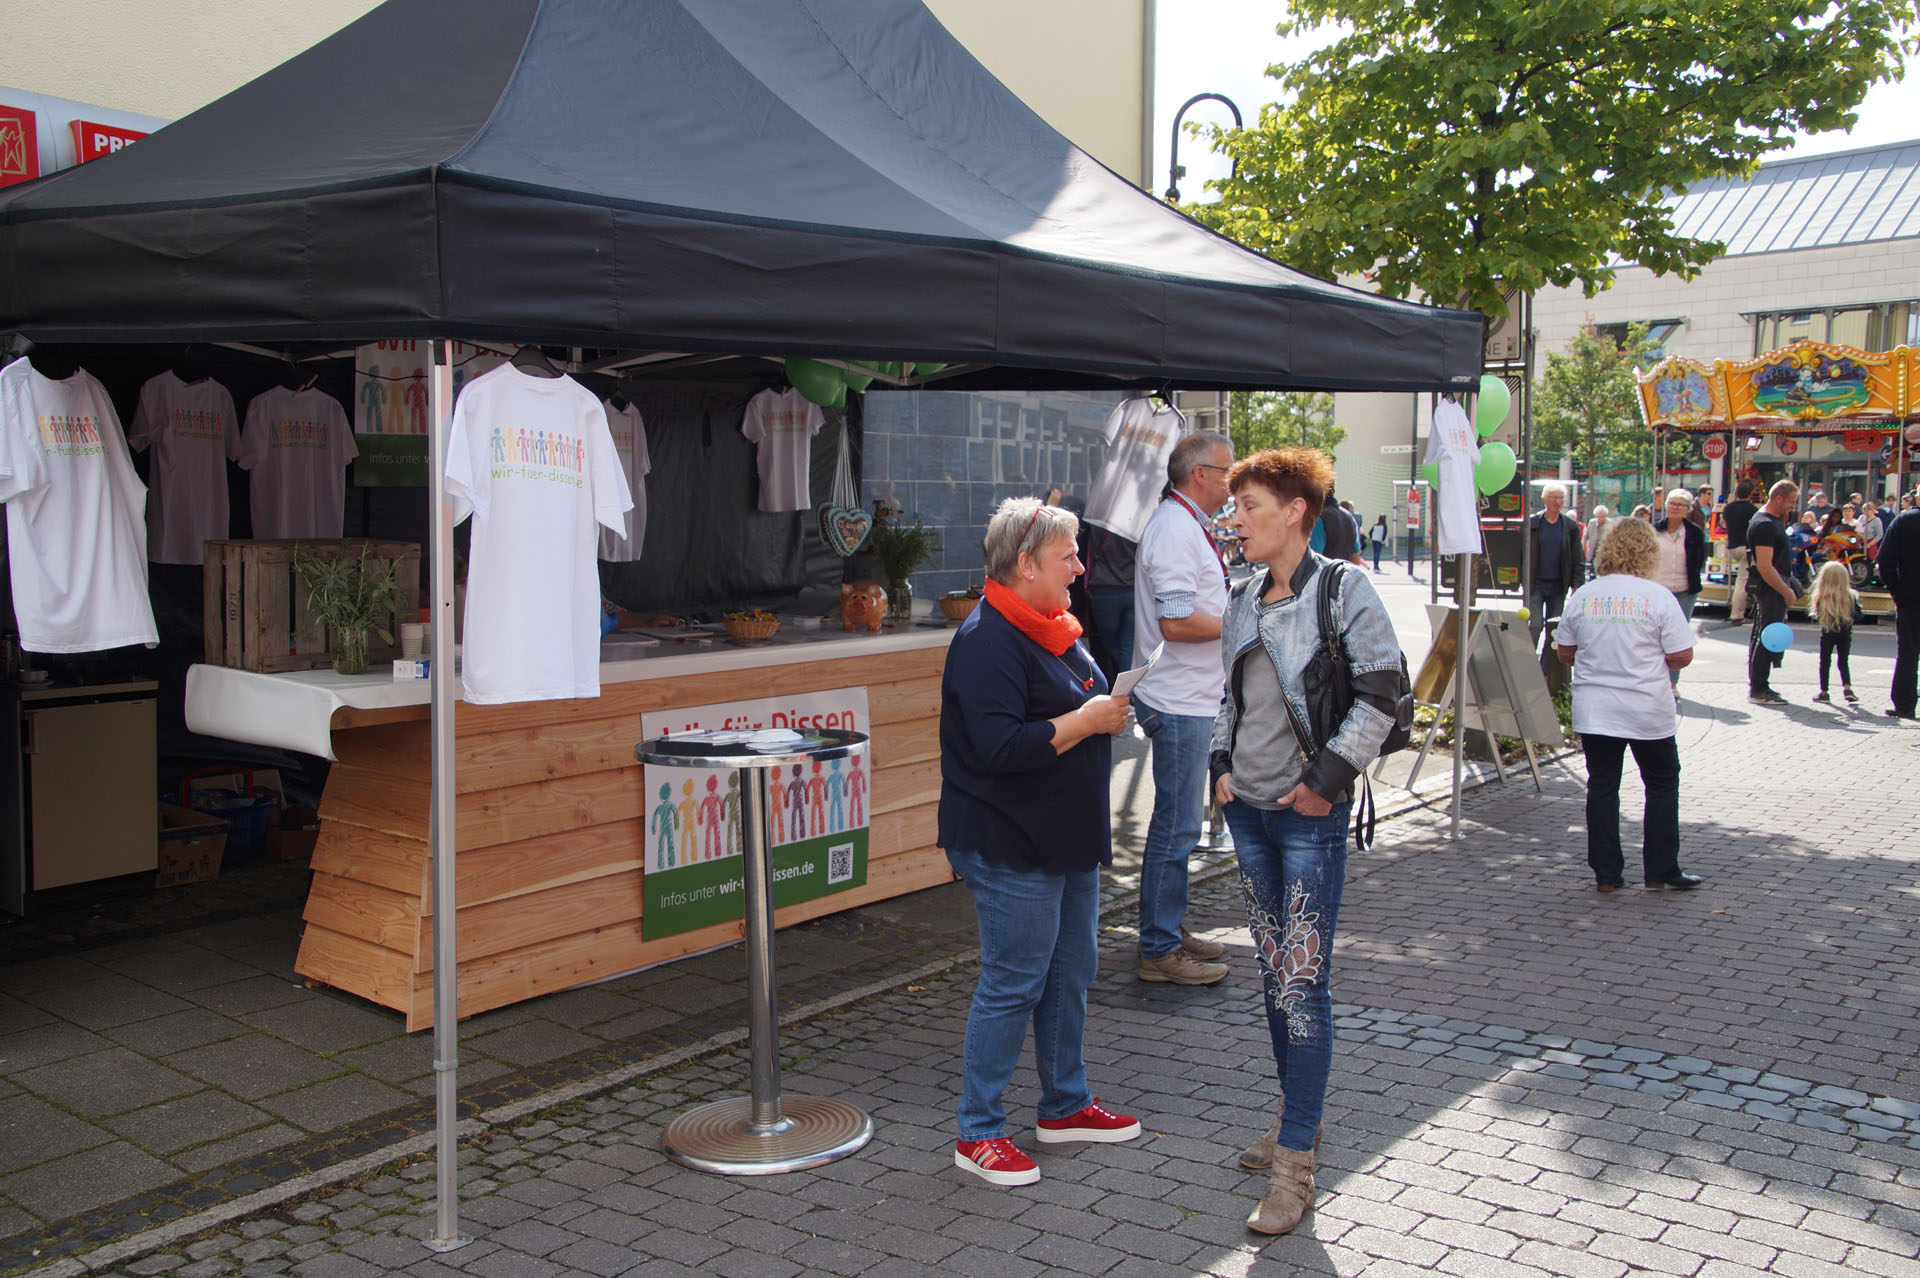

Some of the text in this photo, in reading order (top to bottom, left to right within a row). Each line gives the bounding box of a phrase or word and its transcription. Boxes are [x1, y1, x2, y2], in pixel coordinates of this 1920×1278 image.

[1704, 443, 1725, 454] STOP
[369, 453, 394, 464] Infos
[396, 453, 421, 465] unter
[660, 861, 815, 908] Infos unter wir-fissen.de
